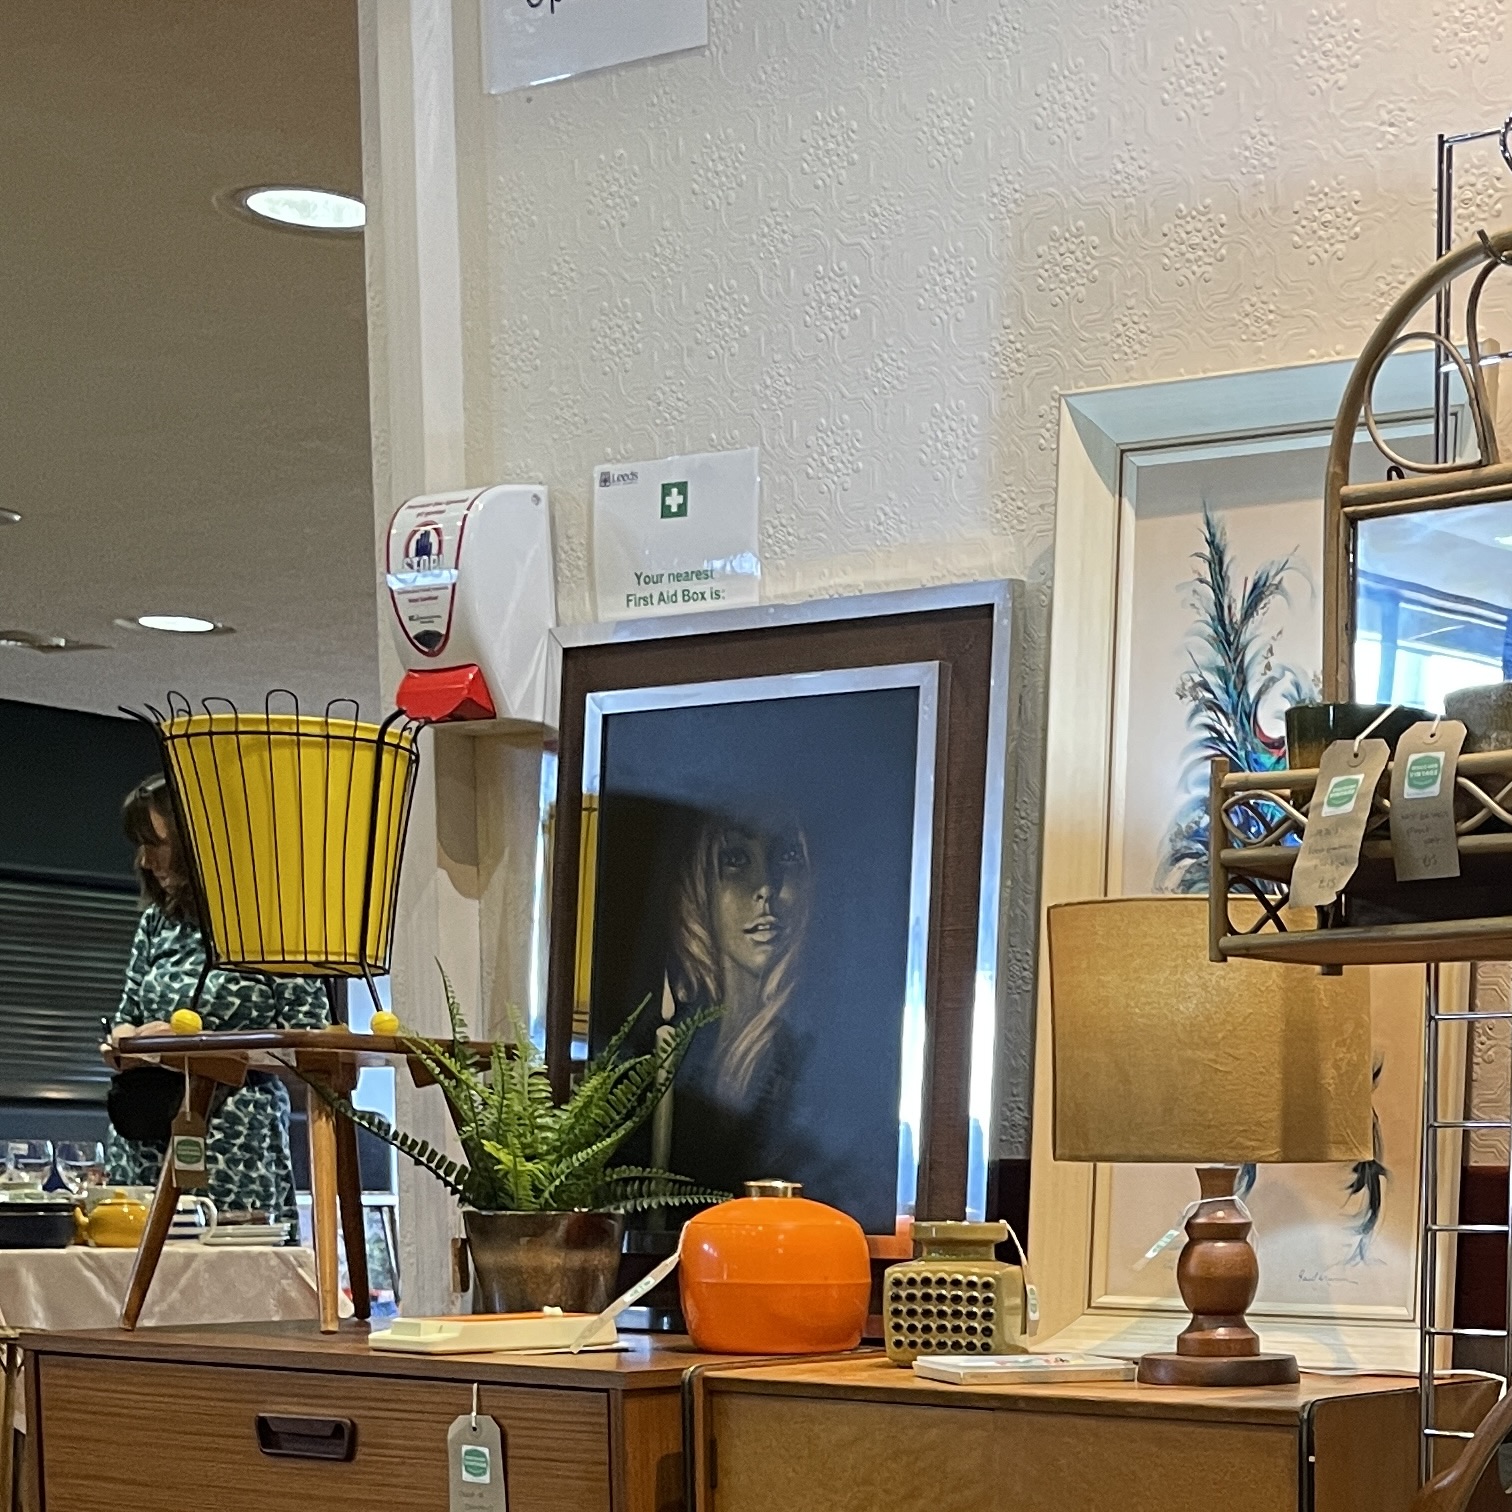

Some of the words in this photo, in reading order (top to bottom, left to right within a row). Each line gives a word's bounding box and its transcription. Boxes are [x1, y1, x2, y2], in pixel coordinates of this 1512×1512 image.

[634, 571, 664, 586] Your
[667, 567, 715, 583] nearest
[626, 592, 654, 608] First
[657, 589, 678, 605] Aid
[682, 588, 707, 603] Box
[709, 586, 726, 601] is:
